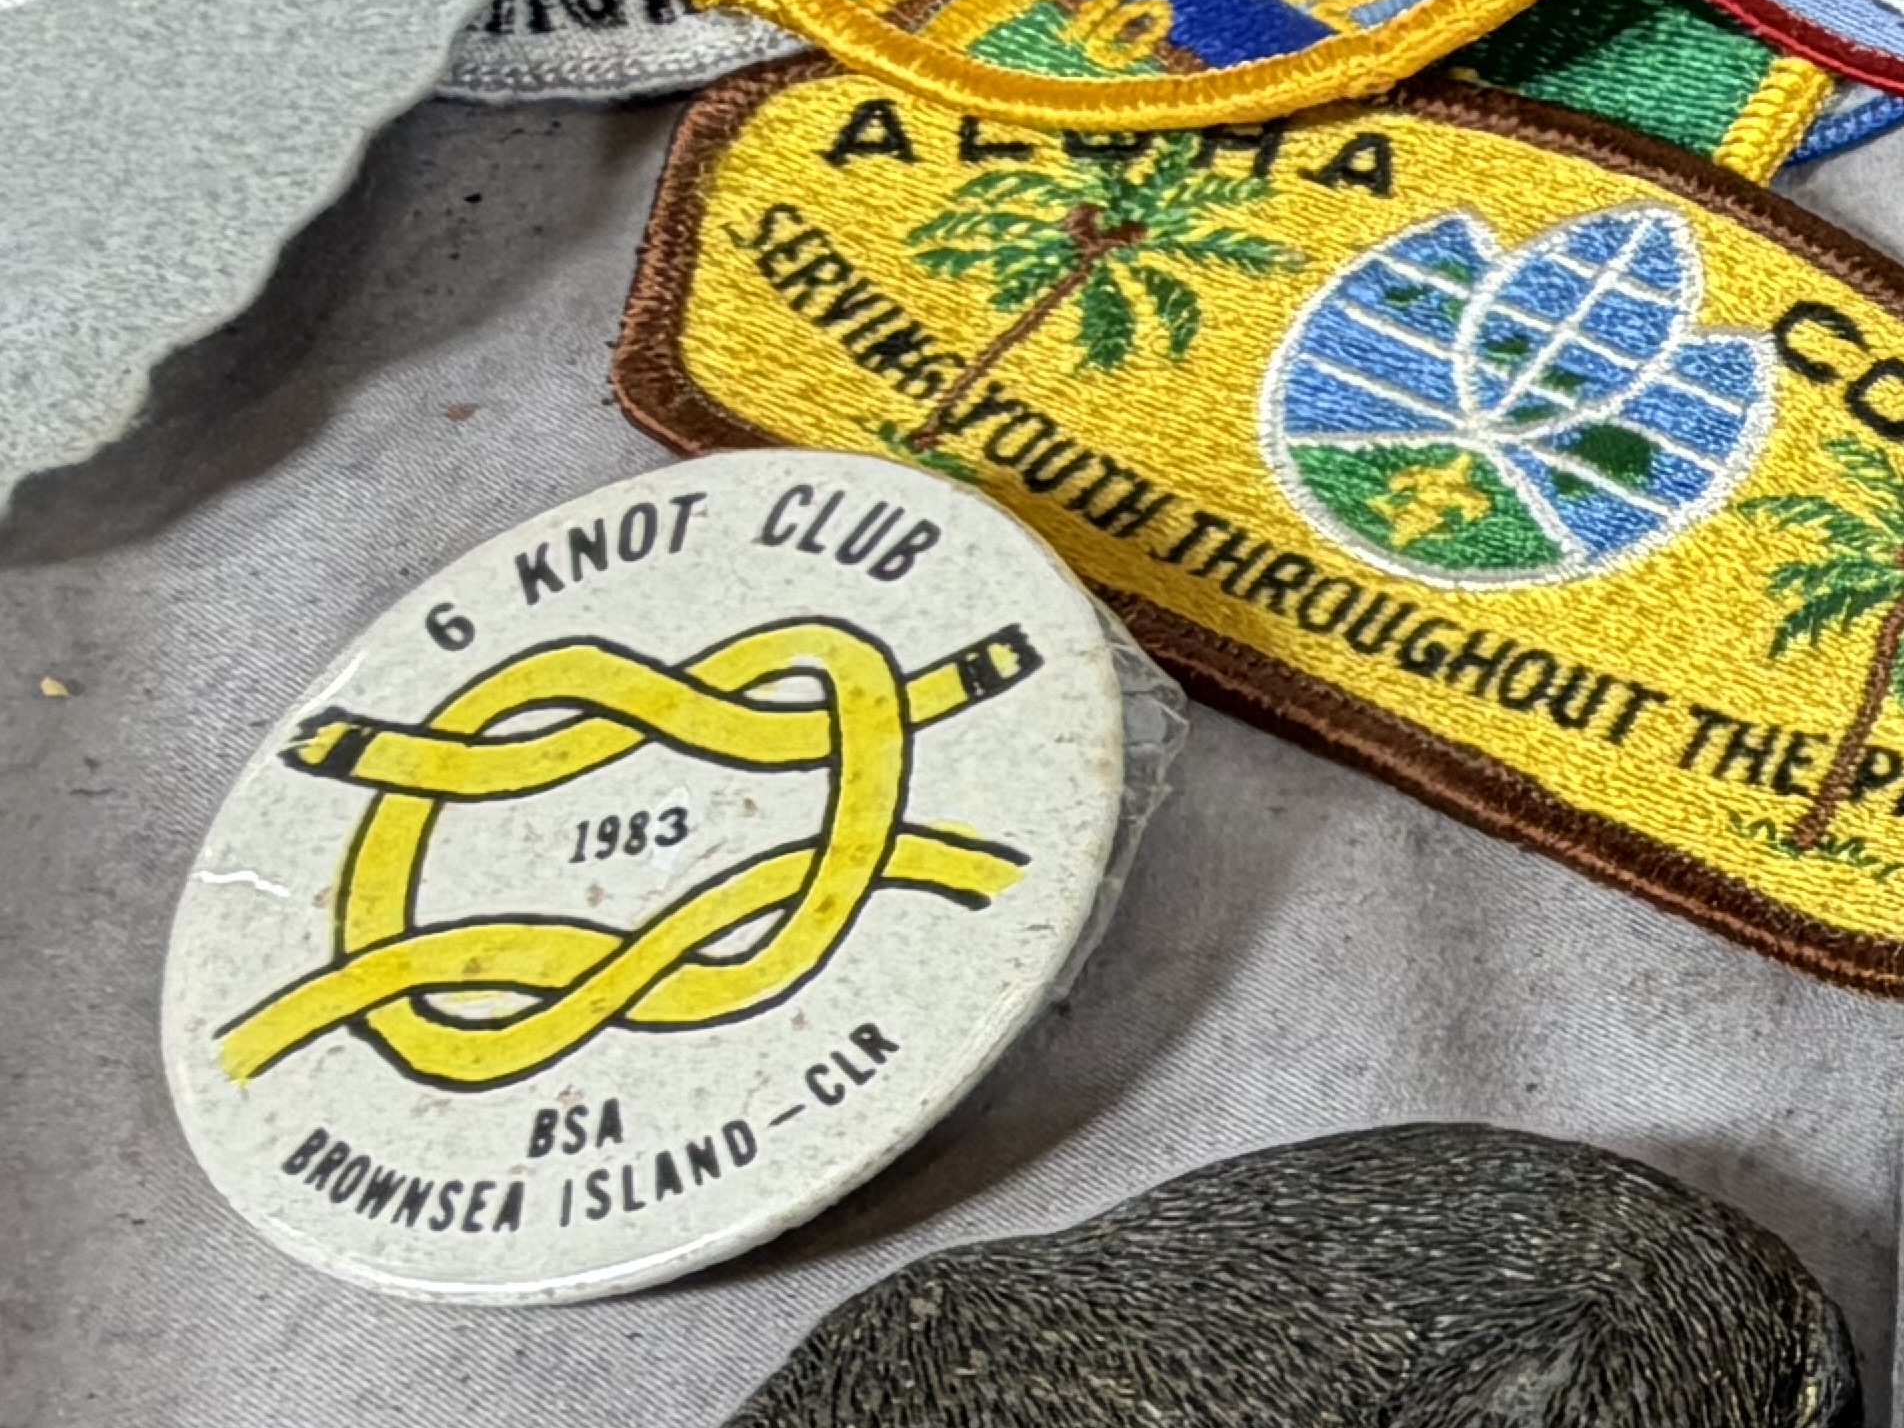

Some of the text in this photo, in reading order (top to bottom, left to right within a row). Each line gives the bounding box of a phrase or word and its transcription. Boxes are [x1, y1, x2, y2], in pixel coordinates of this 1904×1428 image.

[723, 203, 965, 402] SERVING
[940, 380, 1168, 544] YOUTH
[1146, 506, 1668, 750] THROUGHOUT
[1667, 702, 1832, 801] THE
[425, 482, 943, 652] 6 KNOT CLUB
[566, 804, 691, 865] 1983
[279, 1125, 526, 1235] BROWNSEA
[525, 1094, 626, 1160] BSA
